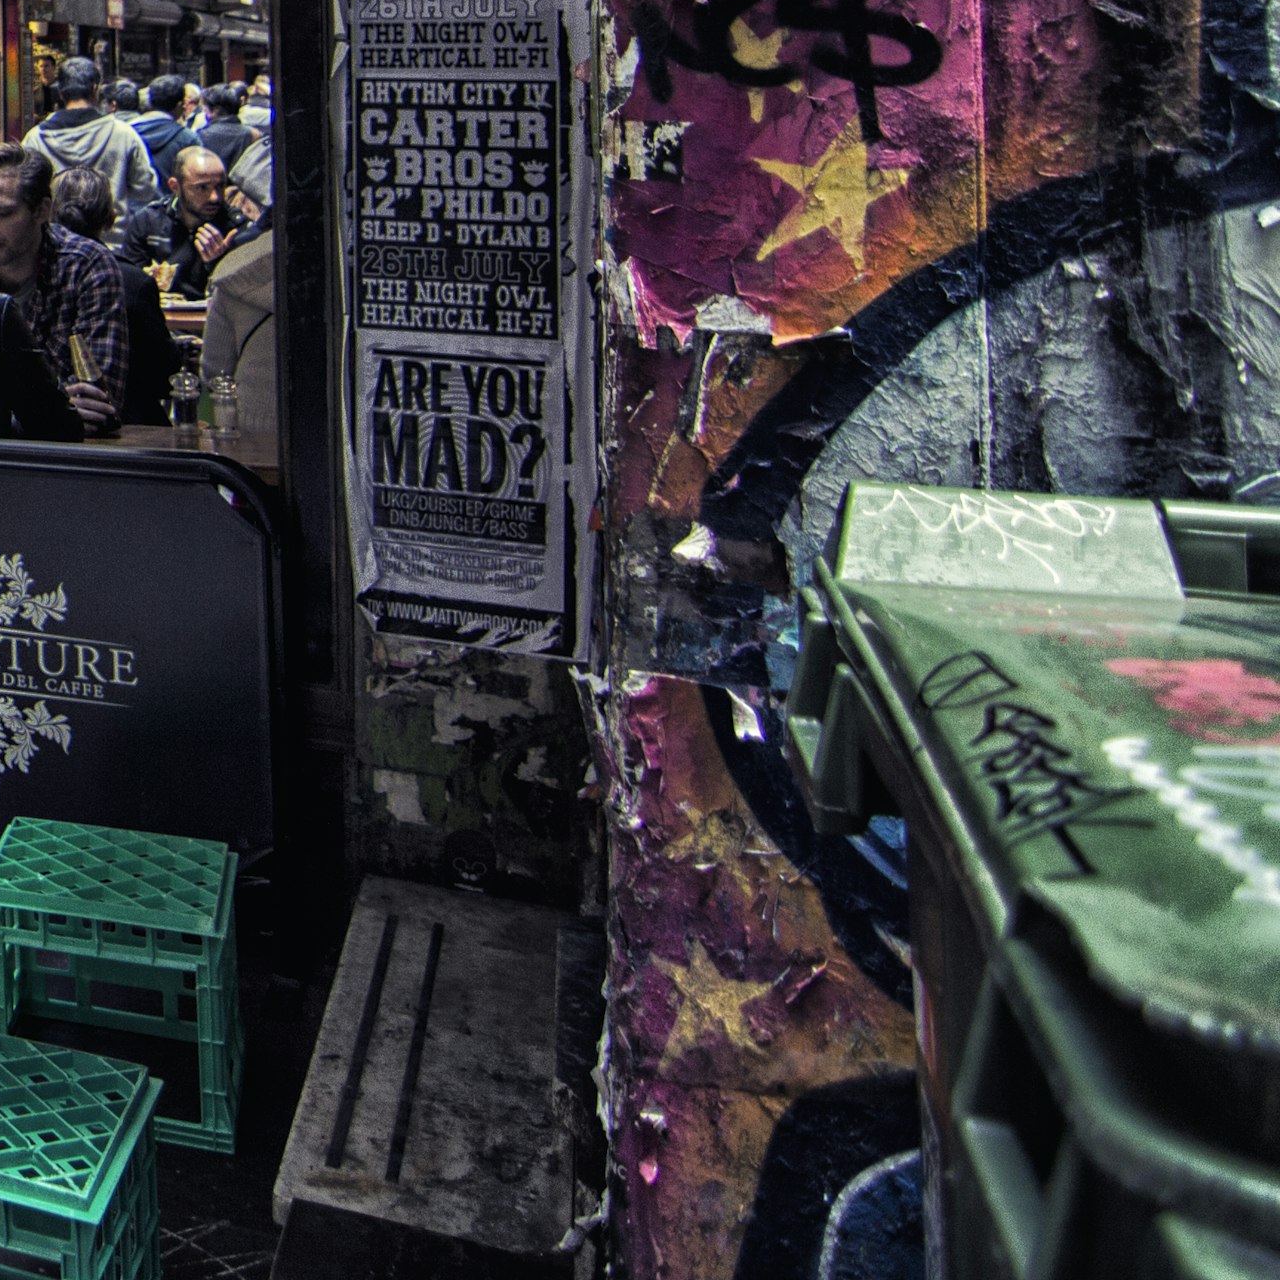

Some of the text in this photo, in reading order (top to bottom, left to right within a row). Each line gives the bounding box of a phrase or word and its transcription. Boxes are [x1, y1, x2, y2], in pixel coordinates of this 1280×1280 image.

[360, 21, 547, 44] THE NIGHT OWL
[359, 47, 549, 69] HEARTICAL HI-FI
[361, 81, 551, 108] RHYTHM CITY IV
[360, 108, 549, 149] CARTER
[394, 149, 514, 188] BROS
[420, 188, 550, 222] PHILDO
[361, 221, 550, 248] SLEEP D DYLAN B
[361, 244, 550, 284] 26TH JULY
[362, 278, 552, 310] THE NIGHT OWL
[362, 303, 553, 336] HEARTICAL HI-FI
[374, 359, 546, 421] ARE YOU
[373, 411, 546, 499] MAD?
[380, 491, 537, 521] UKG/DUBSTEP/GRIME
[390, 509, 529, 539] DNB/JUNGLE/BASS
[390, 545, 409, 560] AUG
[411, 548, 422, 560] 10
[455, 553, 503, 571] BASEMENT
[433, 570, 457, 582] FREE
[458, 570, 486, 585] ENTRY
[494, 575, 524, 590] BRING
[2, 671, 40, 691] DEL
[45, 679, 105, 699] CAFFE
